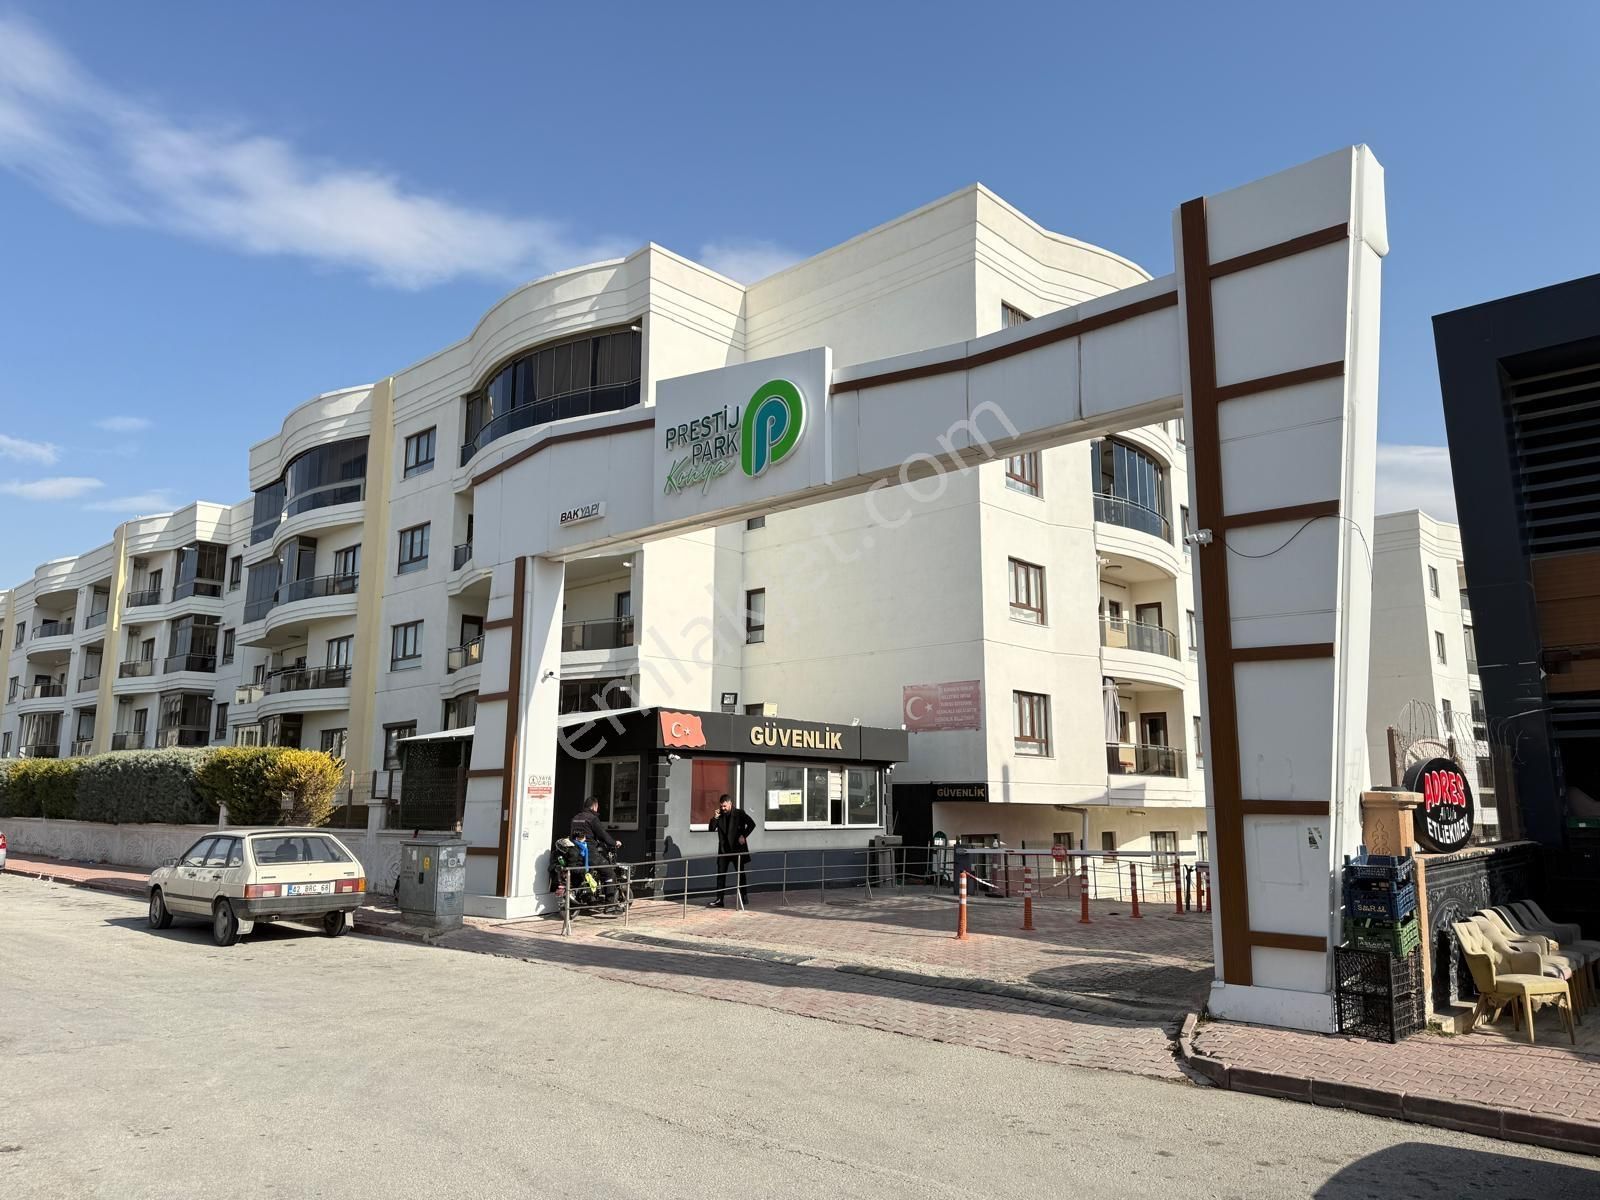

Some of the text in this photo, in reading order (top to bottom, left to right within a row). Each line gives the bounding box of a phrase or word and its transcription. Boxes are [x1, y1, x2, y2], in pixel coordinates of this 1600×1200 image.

[665, 404, 740, 449] PRESTİJ
[692, 431, 739, 466] PARK
[664, 456, 735, 496] Konya
[750, 721, 843, 750] GÜVENLİK
[936, 786, 985, 798] GÜVENLİK
[1425, 769, 1466, 812] ADRES
[292, 885, 301, 893] 42
